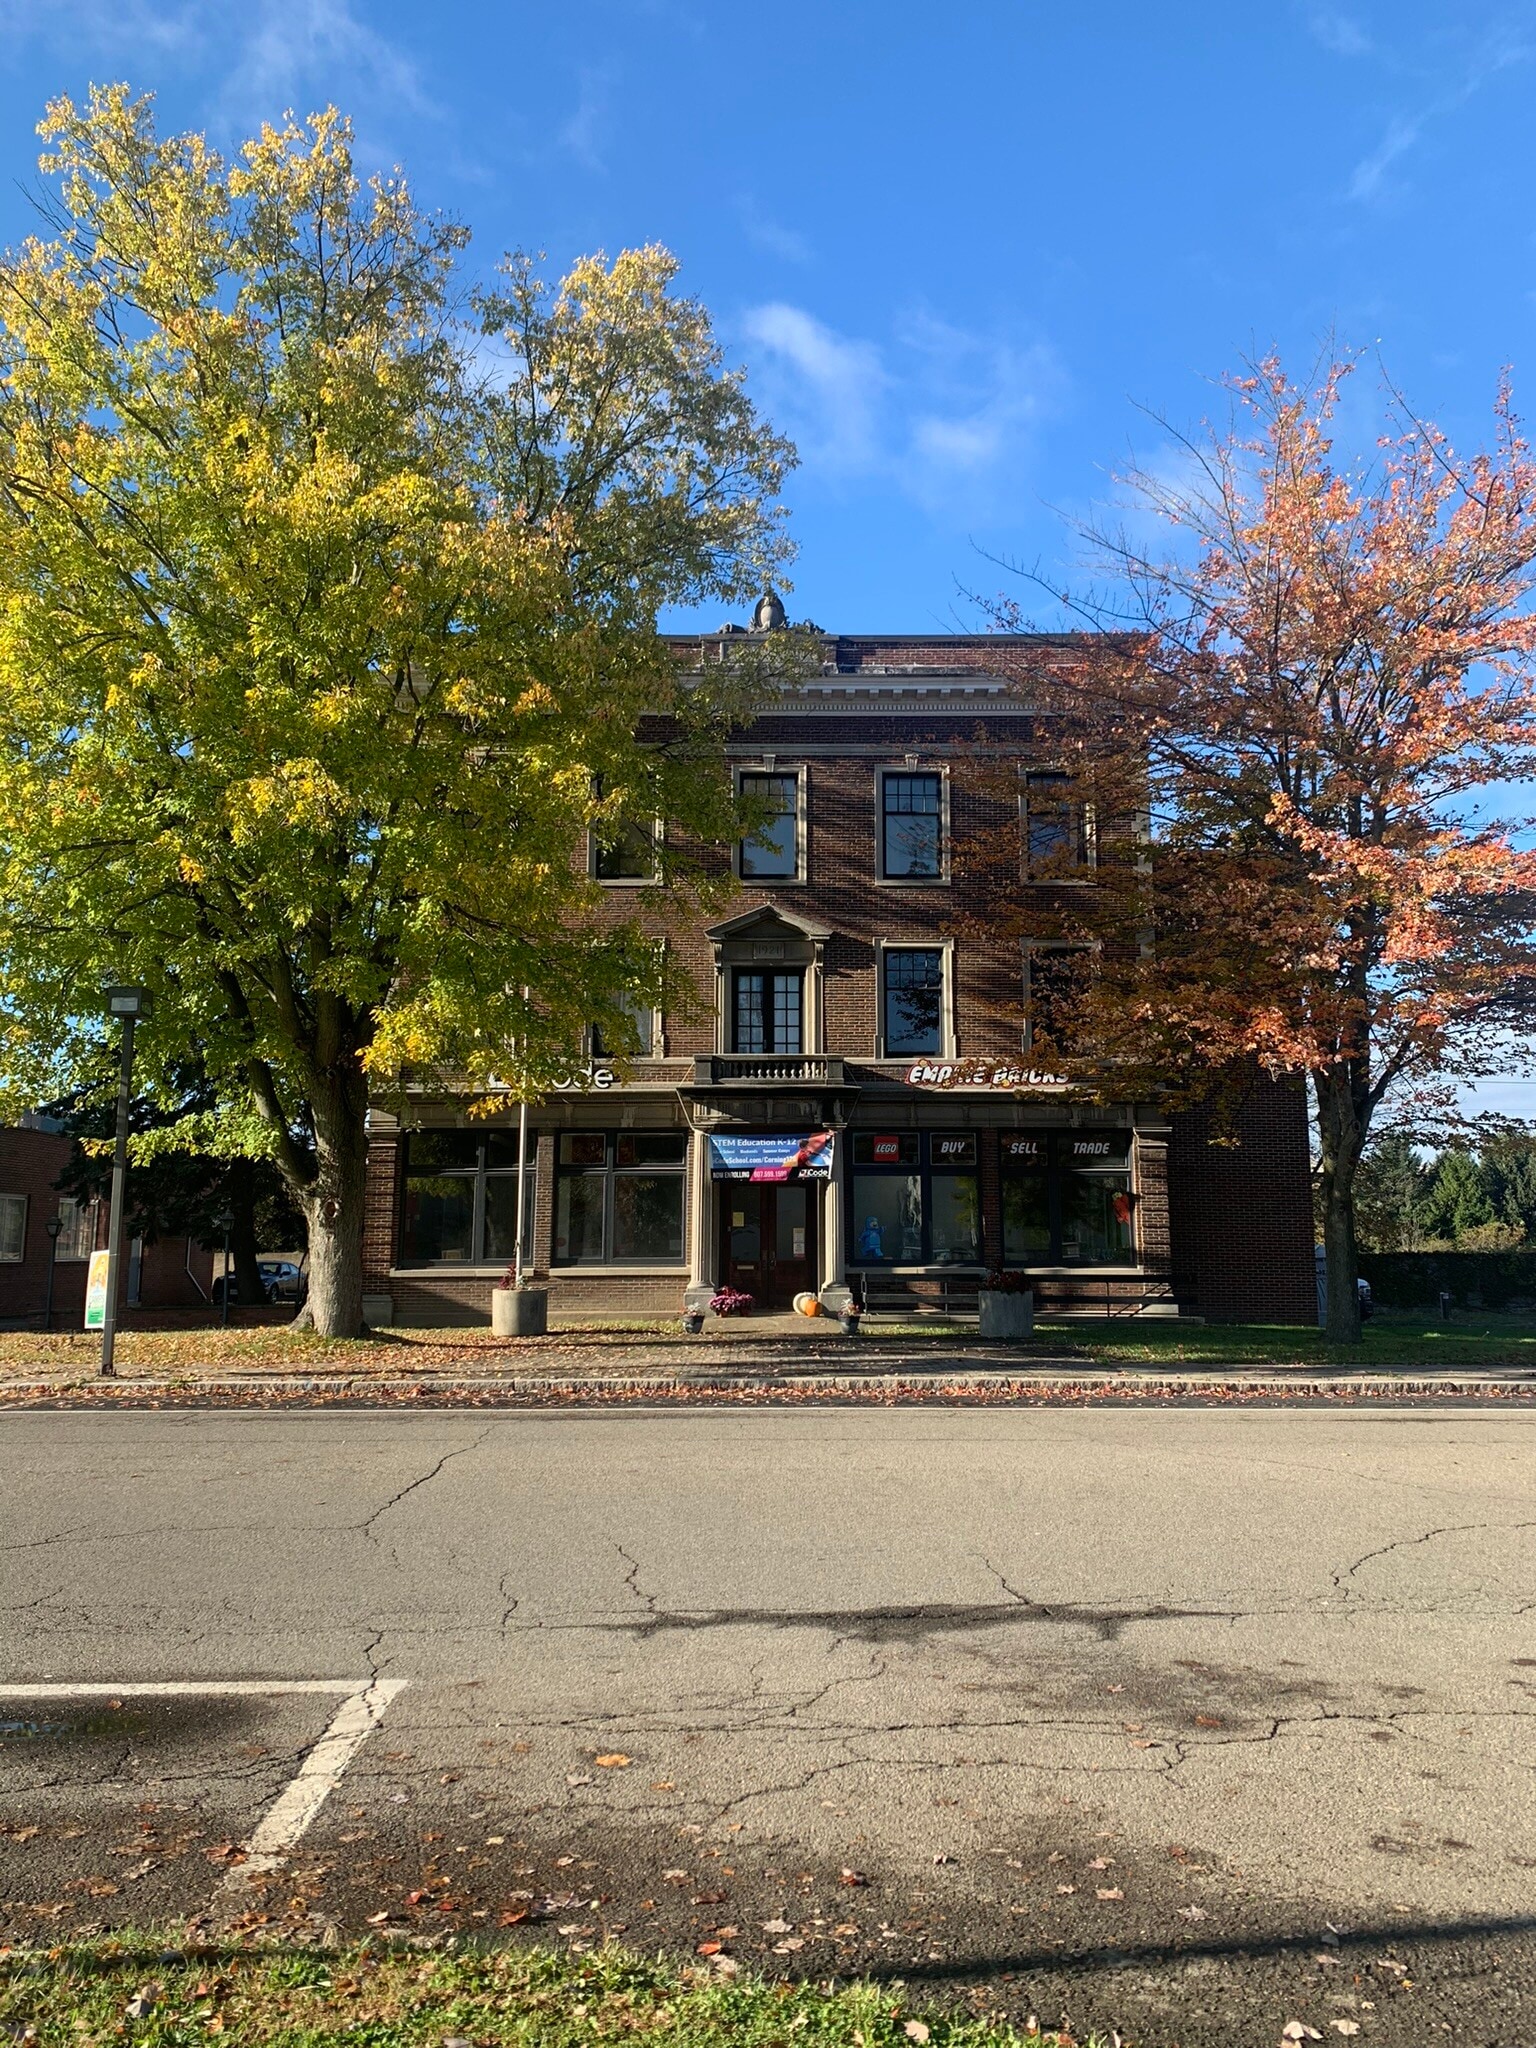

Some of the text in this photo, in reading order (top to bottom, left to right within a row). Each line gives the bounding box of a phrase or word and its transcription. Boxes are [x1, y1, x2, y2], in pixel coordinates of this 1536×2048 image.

[737, 1138, 776, 1146] Education
[777, 1138, 797, 1146] K-12
[941, 1142, 965, 1153] BUY
[876, 1144, 897, 1153] LEGO
[1010, 1142, 1038, 1154] SELL
[1073, 1142, 1110, 1154] TRADE
